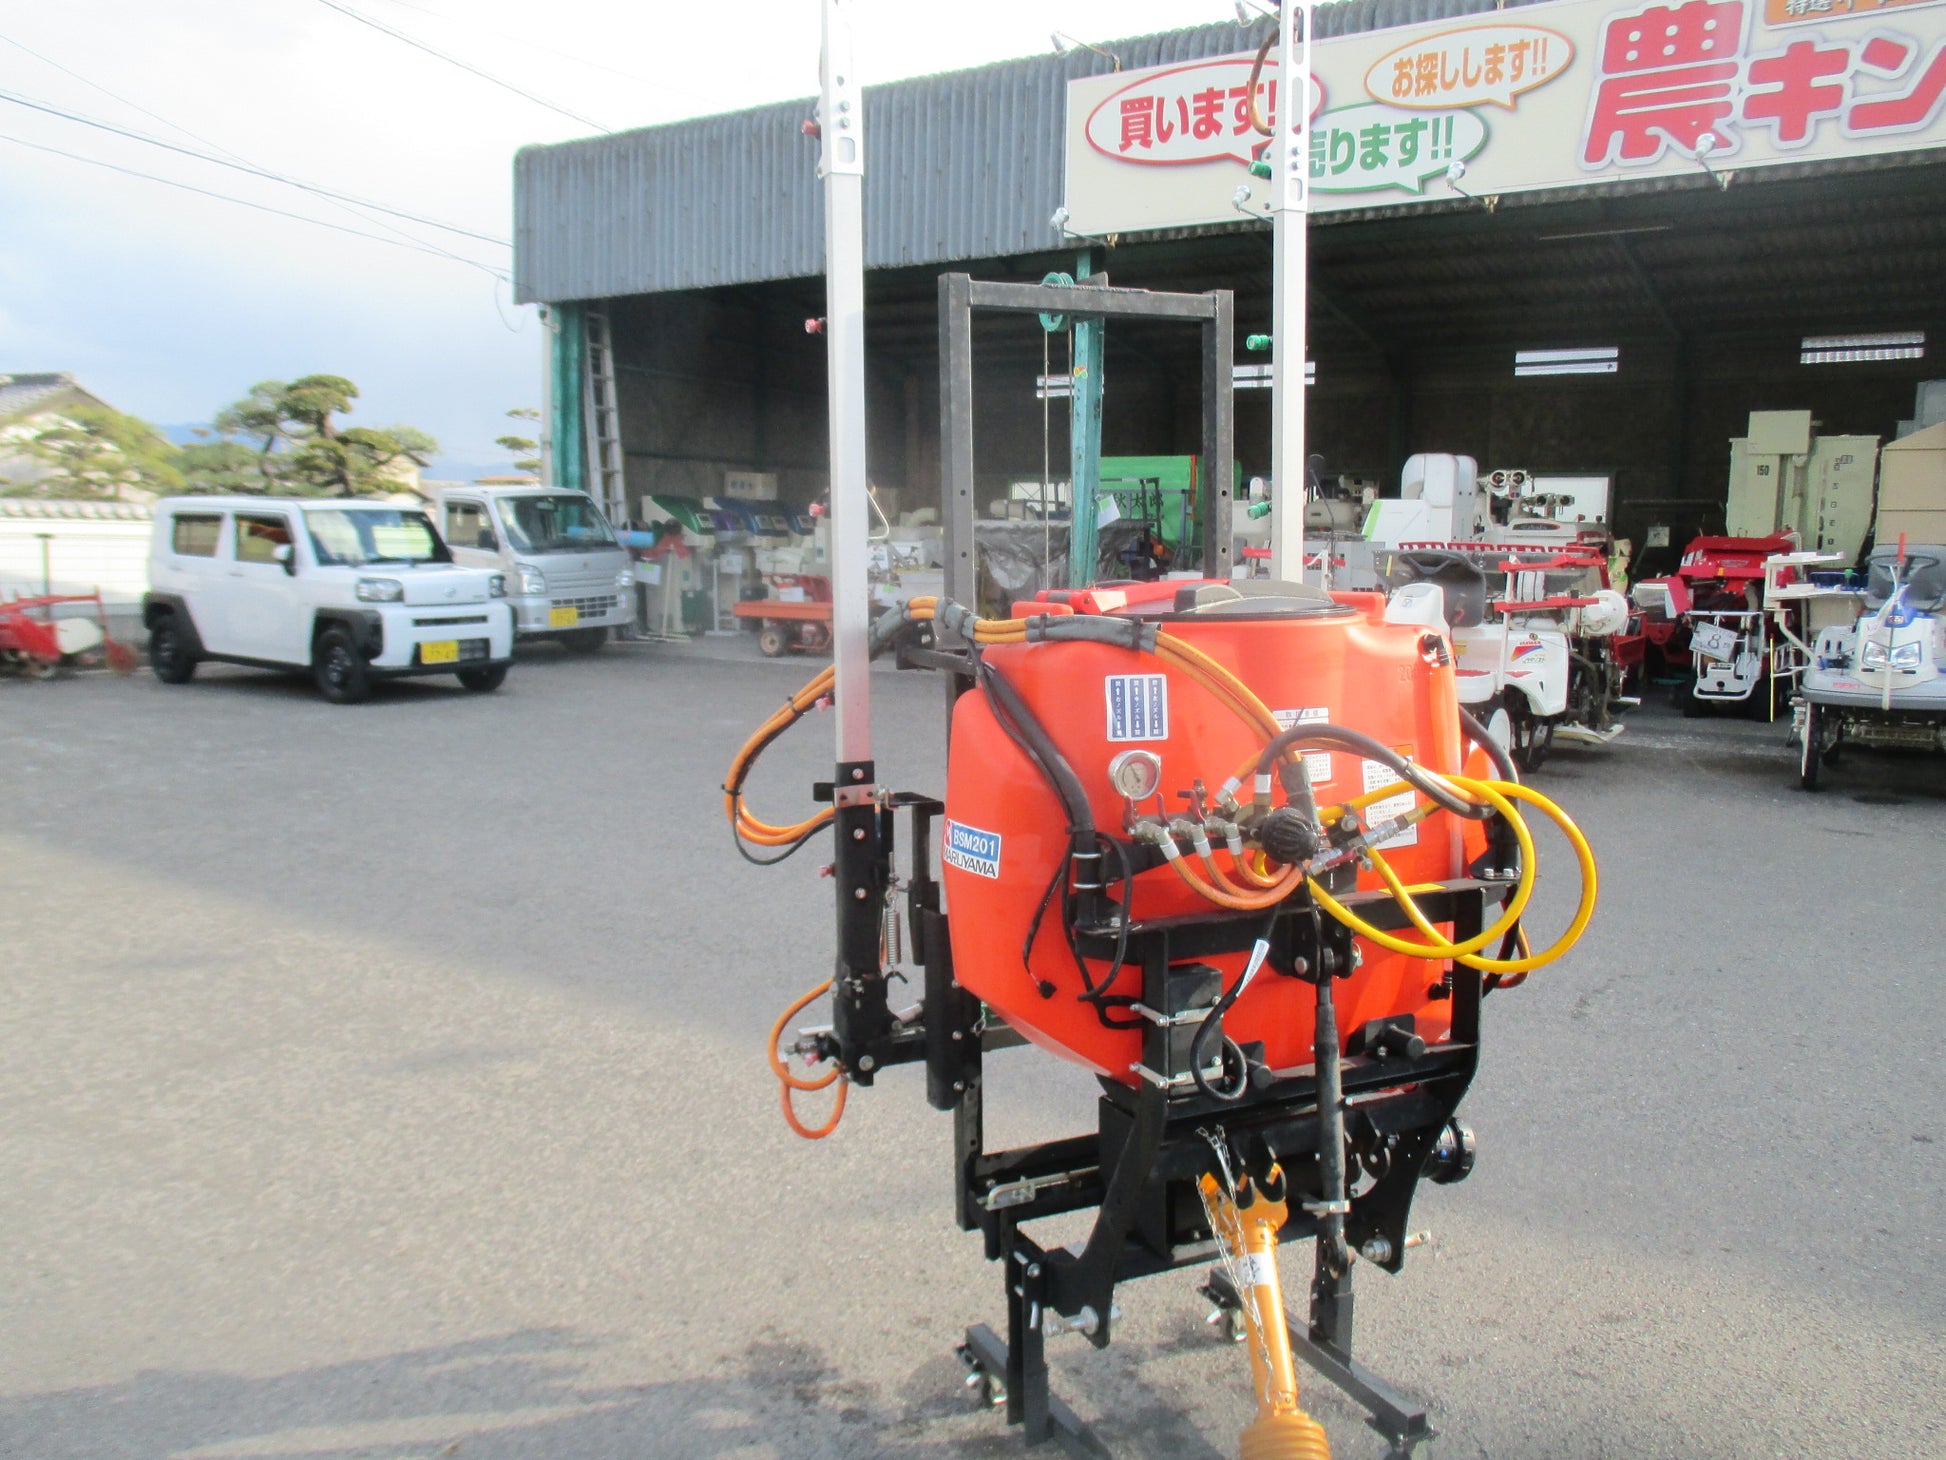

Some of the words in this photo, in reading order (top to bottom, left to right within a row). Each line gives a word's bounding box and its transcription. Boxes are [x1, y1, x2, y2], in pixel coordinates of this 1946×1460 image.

[1391, 36, 1548, 98] お探しします!!
[1756, 465, 1770, 476] 150
[953, 828, 995, 857] BSM201
